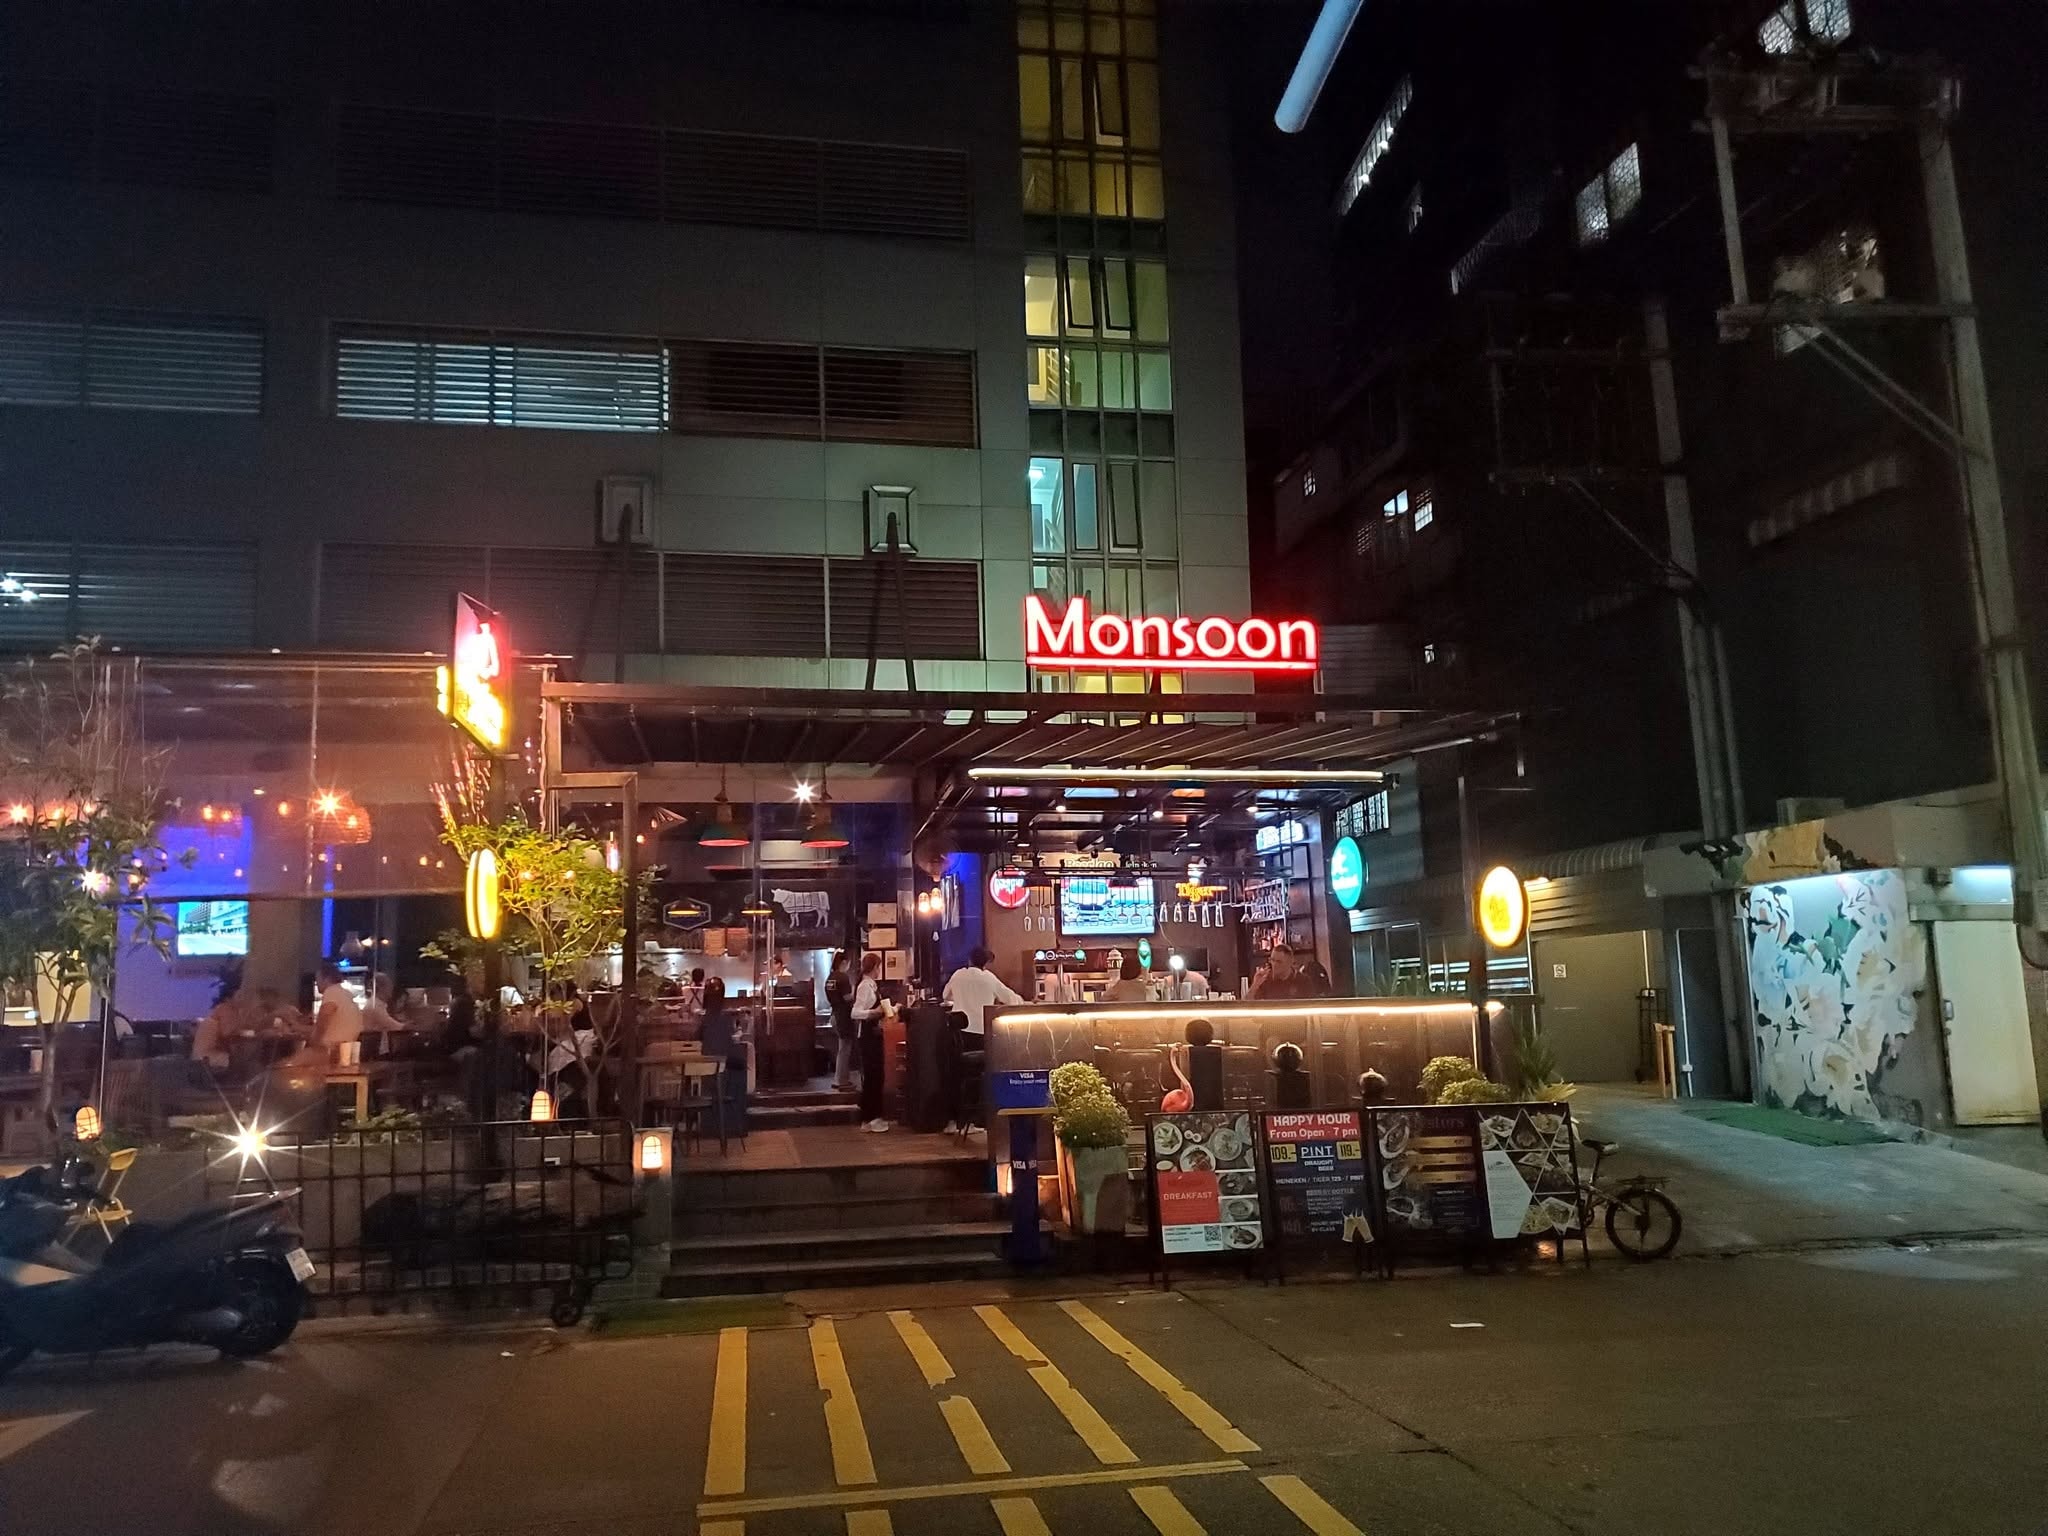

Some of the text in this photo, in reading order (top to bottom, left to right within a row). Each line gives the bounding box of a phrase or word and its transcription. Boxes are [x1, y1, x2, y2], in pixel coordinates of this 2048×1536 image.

[1025, 595, 1317, 660] Monsoon
[1273, 1113, 1351, 1127] HAPPY HOUR
[1269, 1129, 1297, 1139] From
[1299, 1128, 1325, 1140] Open
[1333, 1127, 1340, 1136] 7
[1342, 1128, 1358, 1138] pm
[1300, 1145, 1333, 1157] PINT
[1012, 1160, 1026, 1170] VISA
[1163, 1191, 1213, 1201] BREAKFAST
